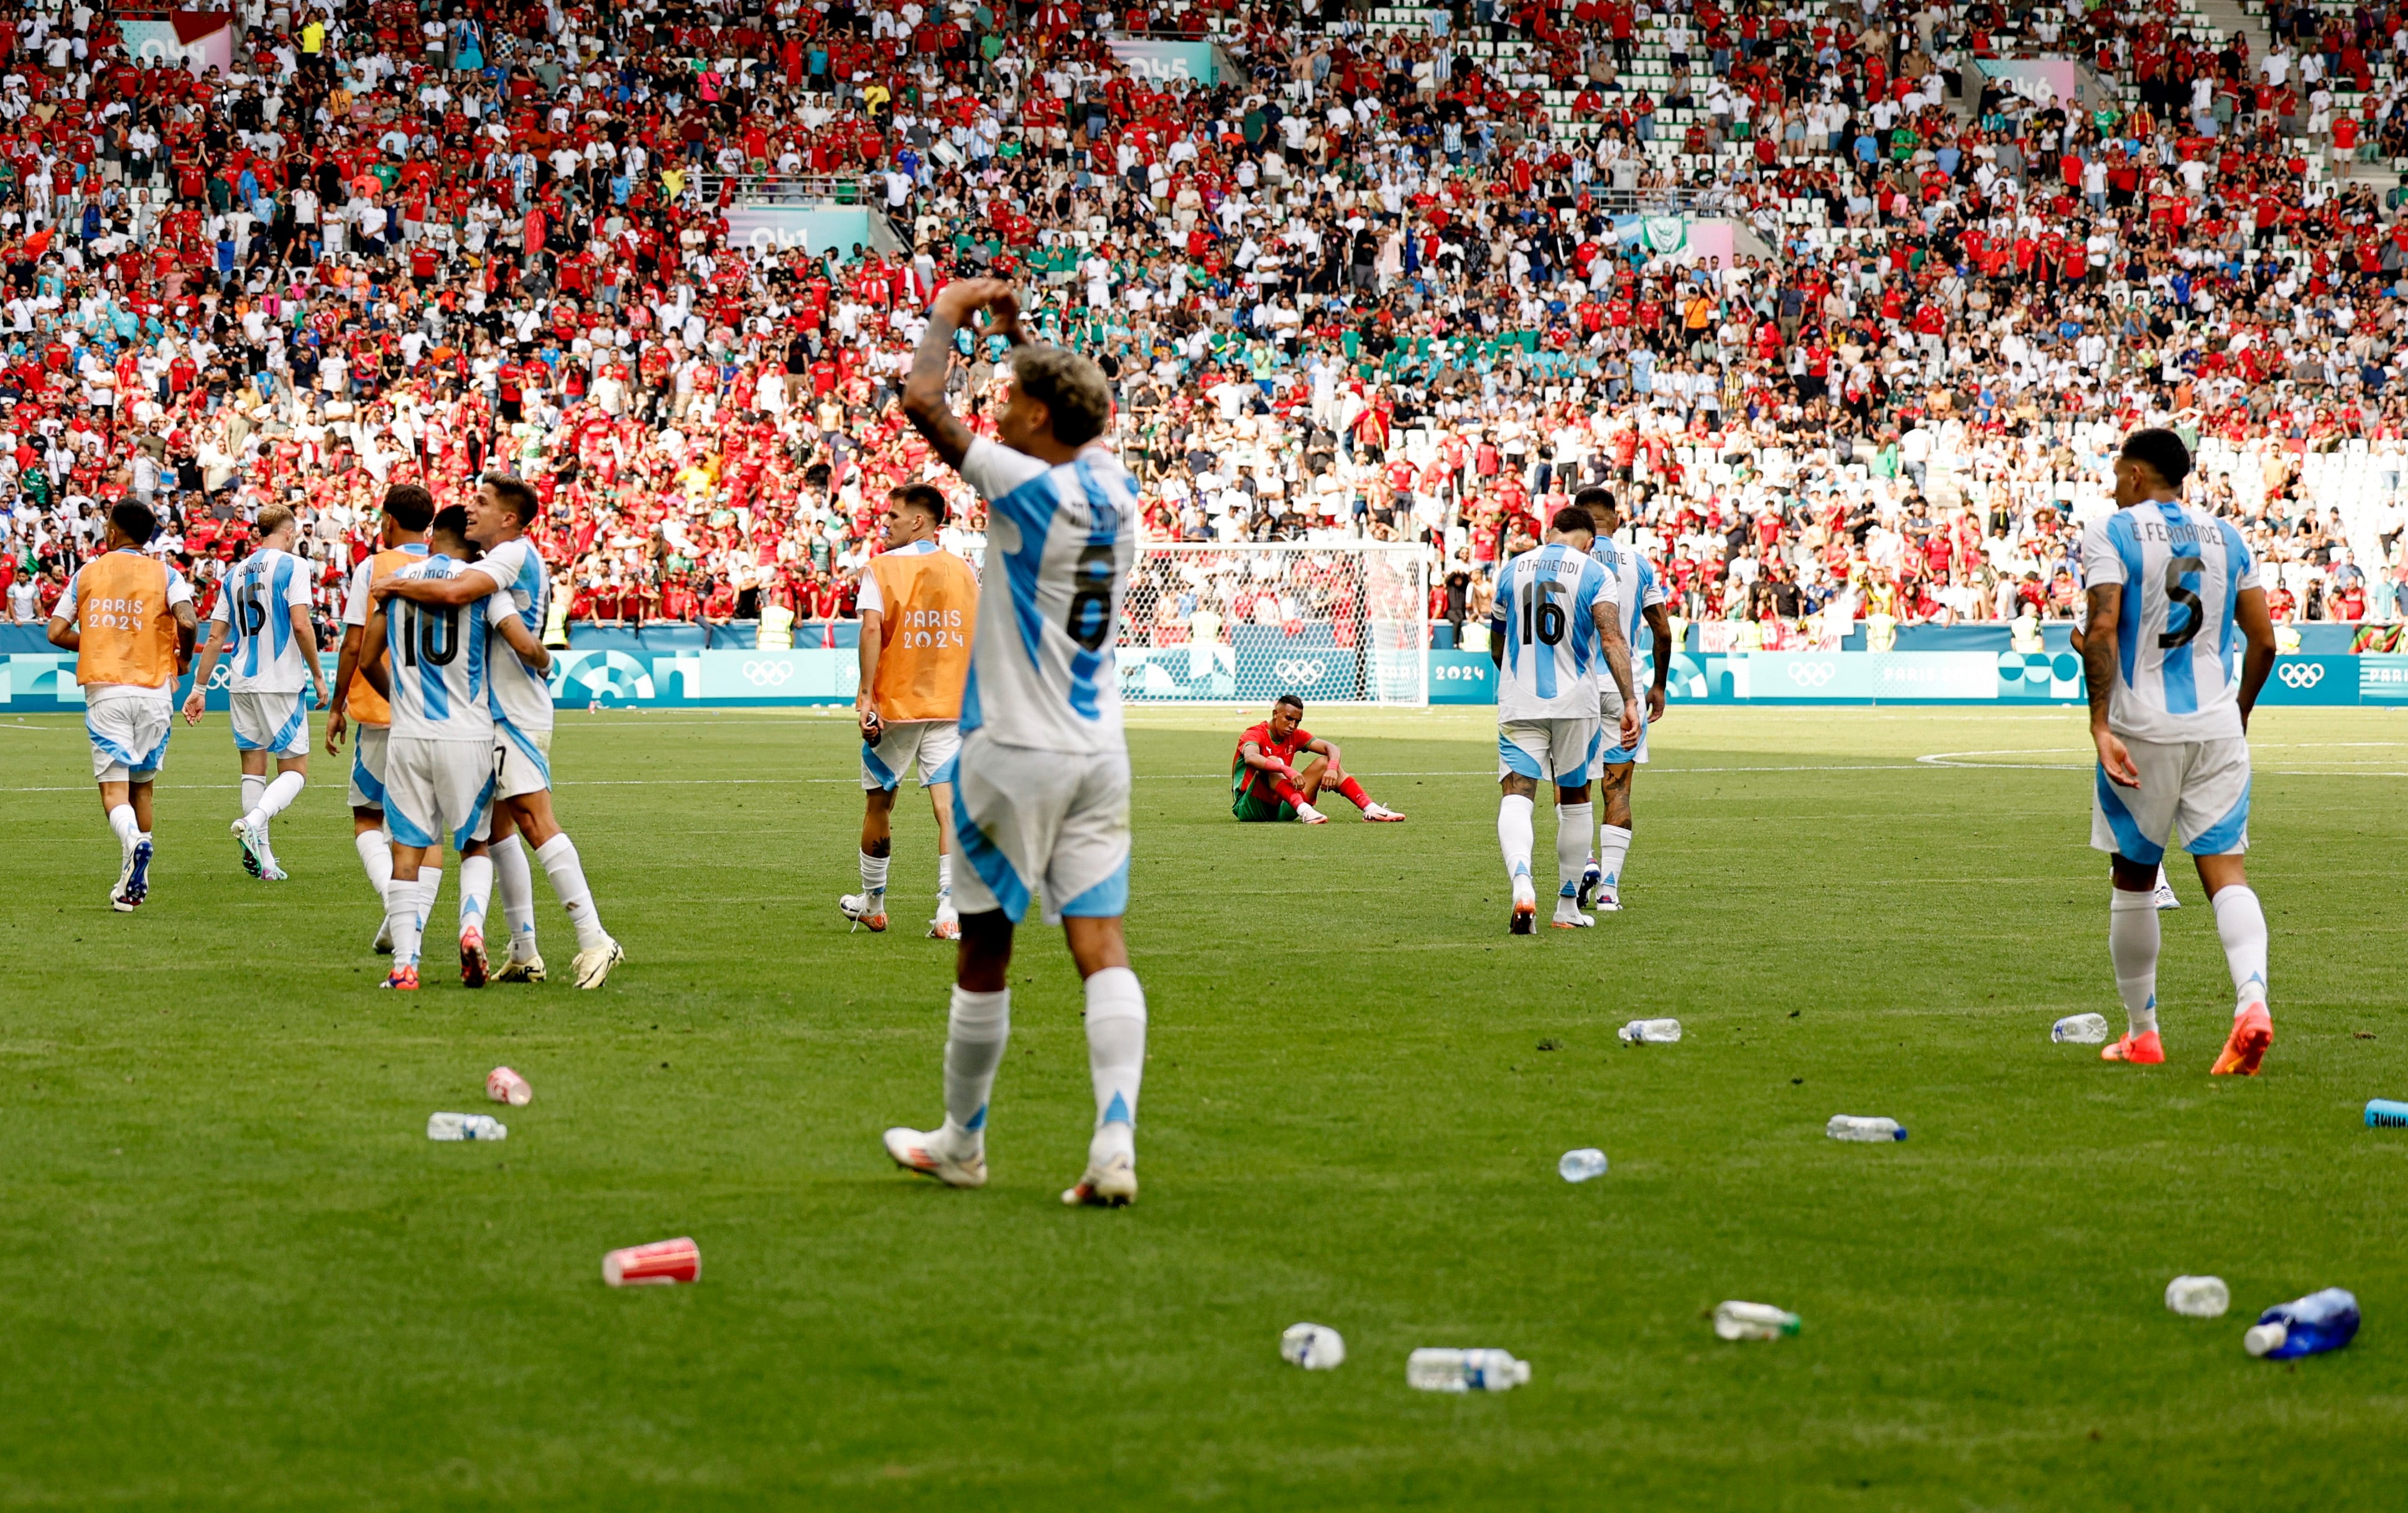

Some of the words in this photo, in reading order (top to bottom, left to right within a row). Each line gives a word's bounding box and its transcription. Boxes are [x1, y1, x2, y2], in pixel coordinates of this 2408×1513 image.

[1589, 550, 1627, 565] MIONE
[1518, 559, 1580, 575] OTAMENDI
[237, 582, 266, 637] 15
[2158, 556, 2205, 649] 5
[1522, 581, 1567, 645] 16
[89, 614, 142, 631] 2024
[404, 599, 459, 667] 10
[904, 631, 964, 649] 2024
[1435, 665, 1484, 680] 2024
